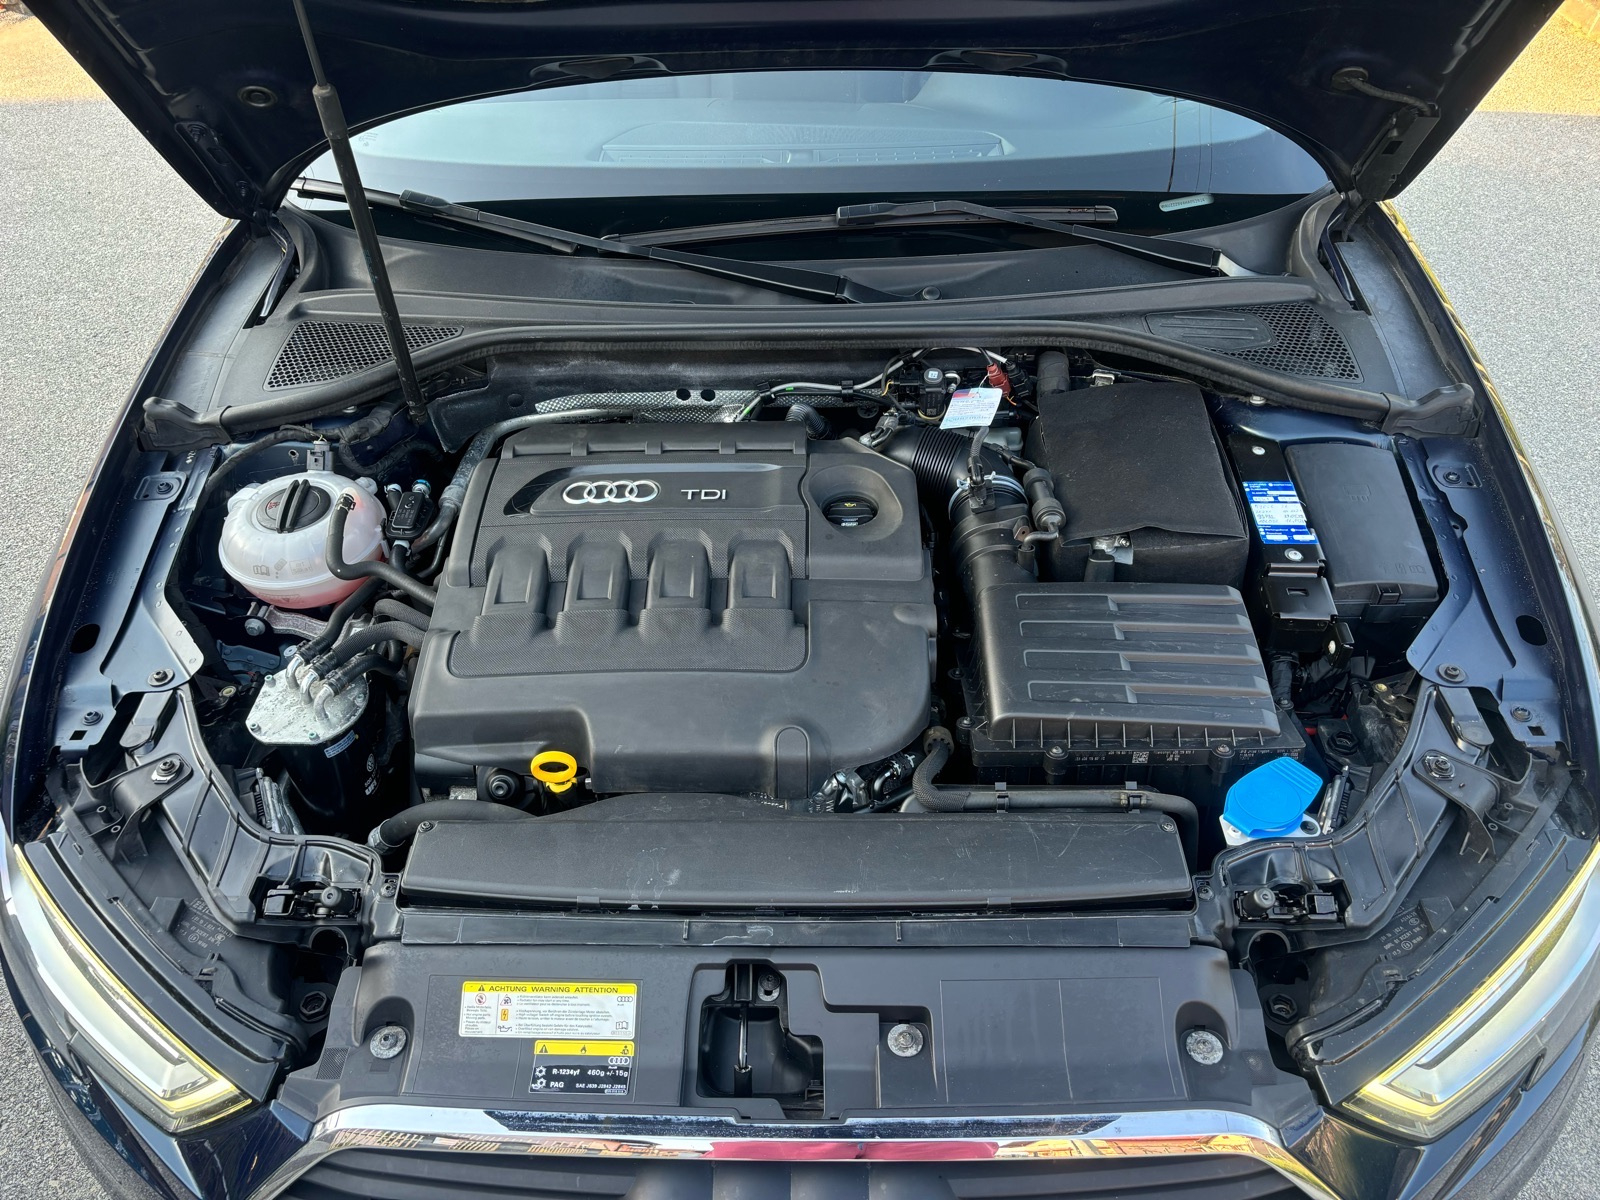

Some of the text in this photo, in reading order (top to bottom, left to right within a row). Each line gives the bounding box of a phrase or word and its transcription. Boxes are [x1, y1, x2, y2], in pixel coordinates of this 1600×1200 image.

[681, 489, 727, 500] TDI
[489, 985, 527, 993] ACHTUNG
[552, 1068, 580, 1077] R-1234yf
